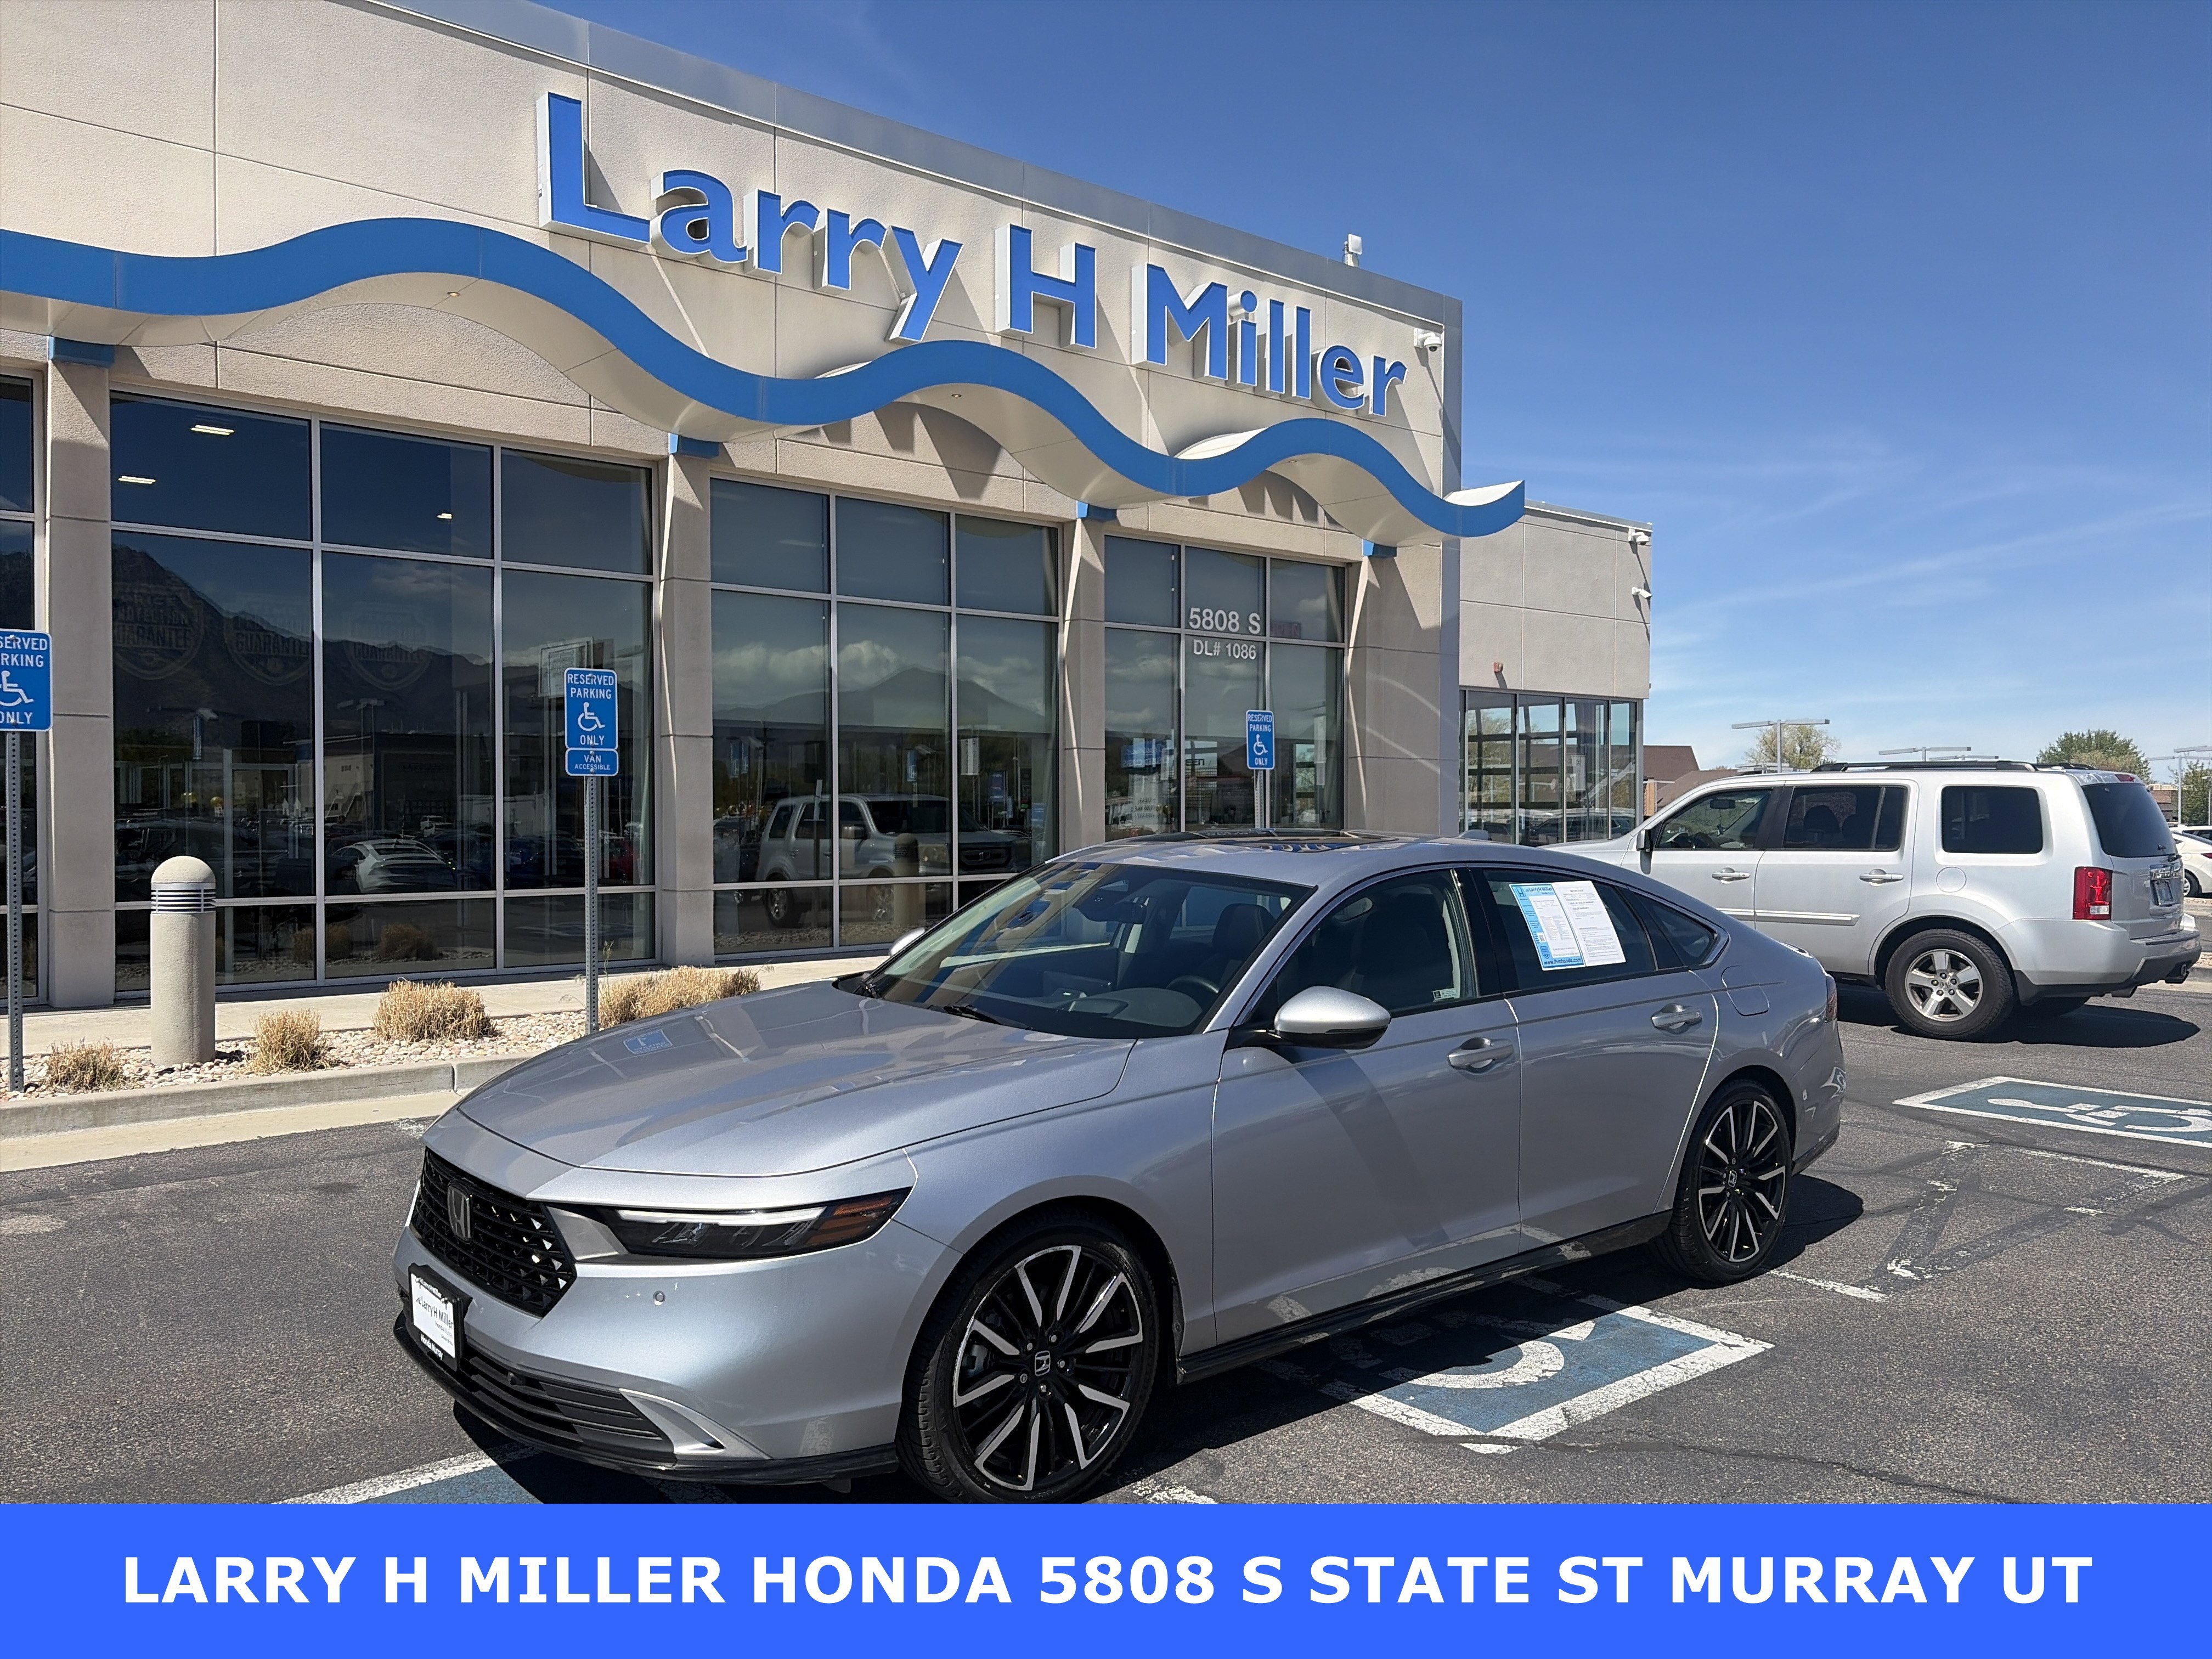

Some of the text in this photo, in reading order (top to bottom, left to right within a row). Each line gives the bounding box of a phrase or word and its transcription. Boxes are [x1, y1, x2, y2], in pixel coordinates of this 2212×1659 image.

[540, 91, 1408, 417] Larry H Miller
[1188, 607, 1261, 635] 5808 S
[1193, 639, 1257, 660] DL# 1086
[567, 673, 614, 686] RESERVED
[571, 687, 612, 700] PARKING
[1248, 714, 1273, 723] RESERVED
[1249, 724, 1272, 733] PARKING
[580, 734, 605, 746] ONLY
[584, 754, 602, 764] VAN
[1255, 758, 1268, 766] ONLY
[421, 1296, 453, 1330] Larry H Miller
[420, 1333, 432, 1350] Honda
